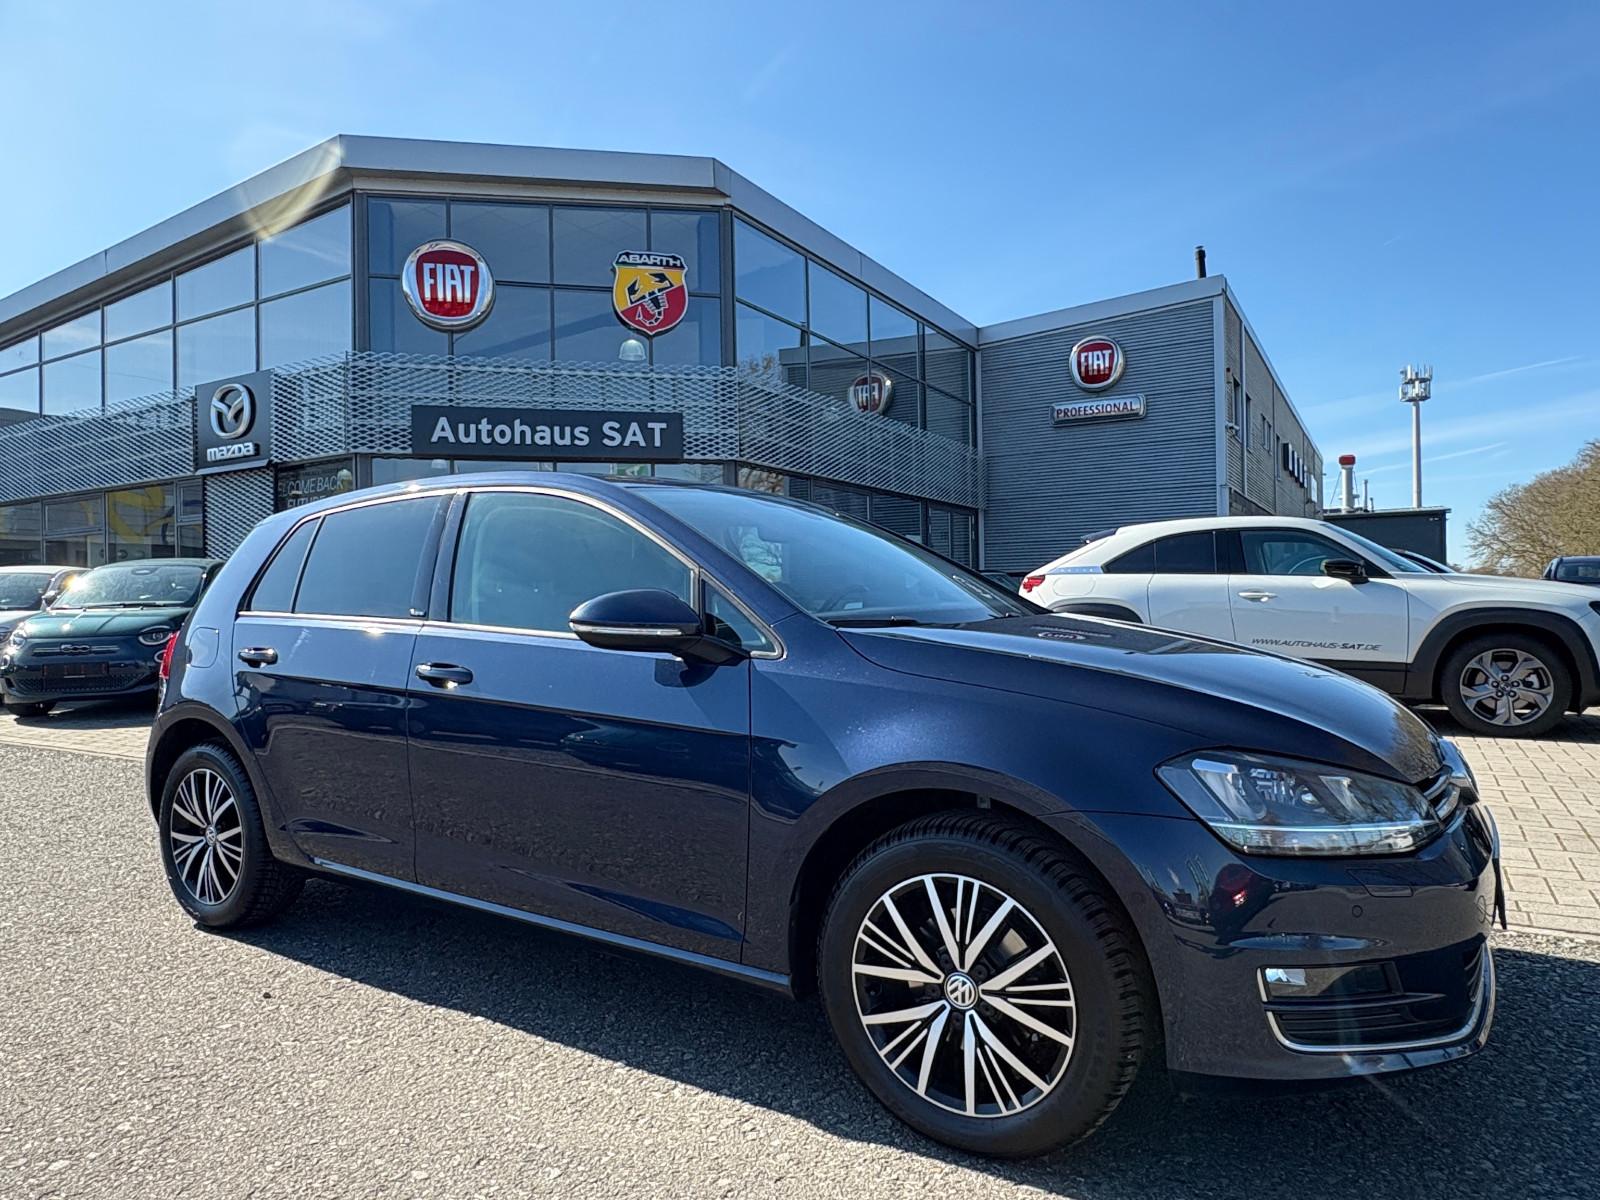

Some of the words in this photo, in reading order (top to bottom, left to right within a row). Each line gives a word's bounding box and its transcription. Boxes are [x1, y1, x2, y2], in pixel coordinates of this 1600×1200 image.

[618, 254, 681, 267] ABARTH
[423, 262, 475, 304] FIAT
[1080, 349, 1112, 377] FIAT
[1056, 401, 1135, 419] PROFESSIONAL
[430, 416, 590, 447] Autohaus
[602, 421, 667, 448] SAT
[1251, 638, 1381, 651] WWW.AUTOHAUS-SAT.DE
